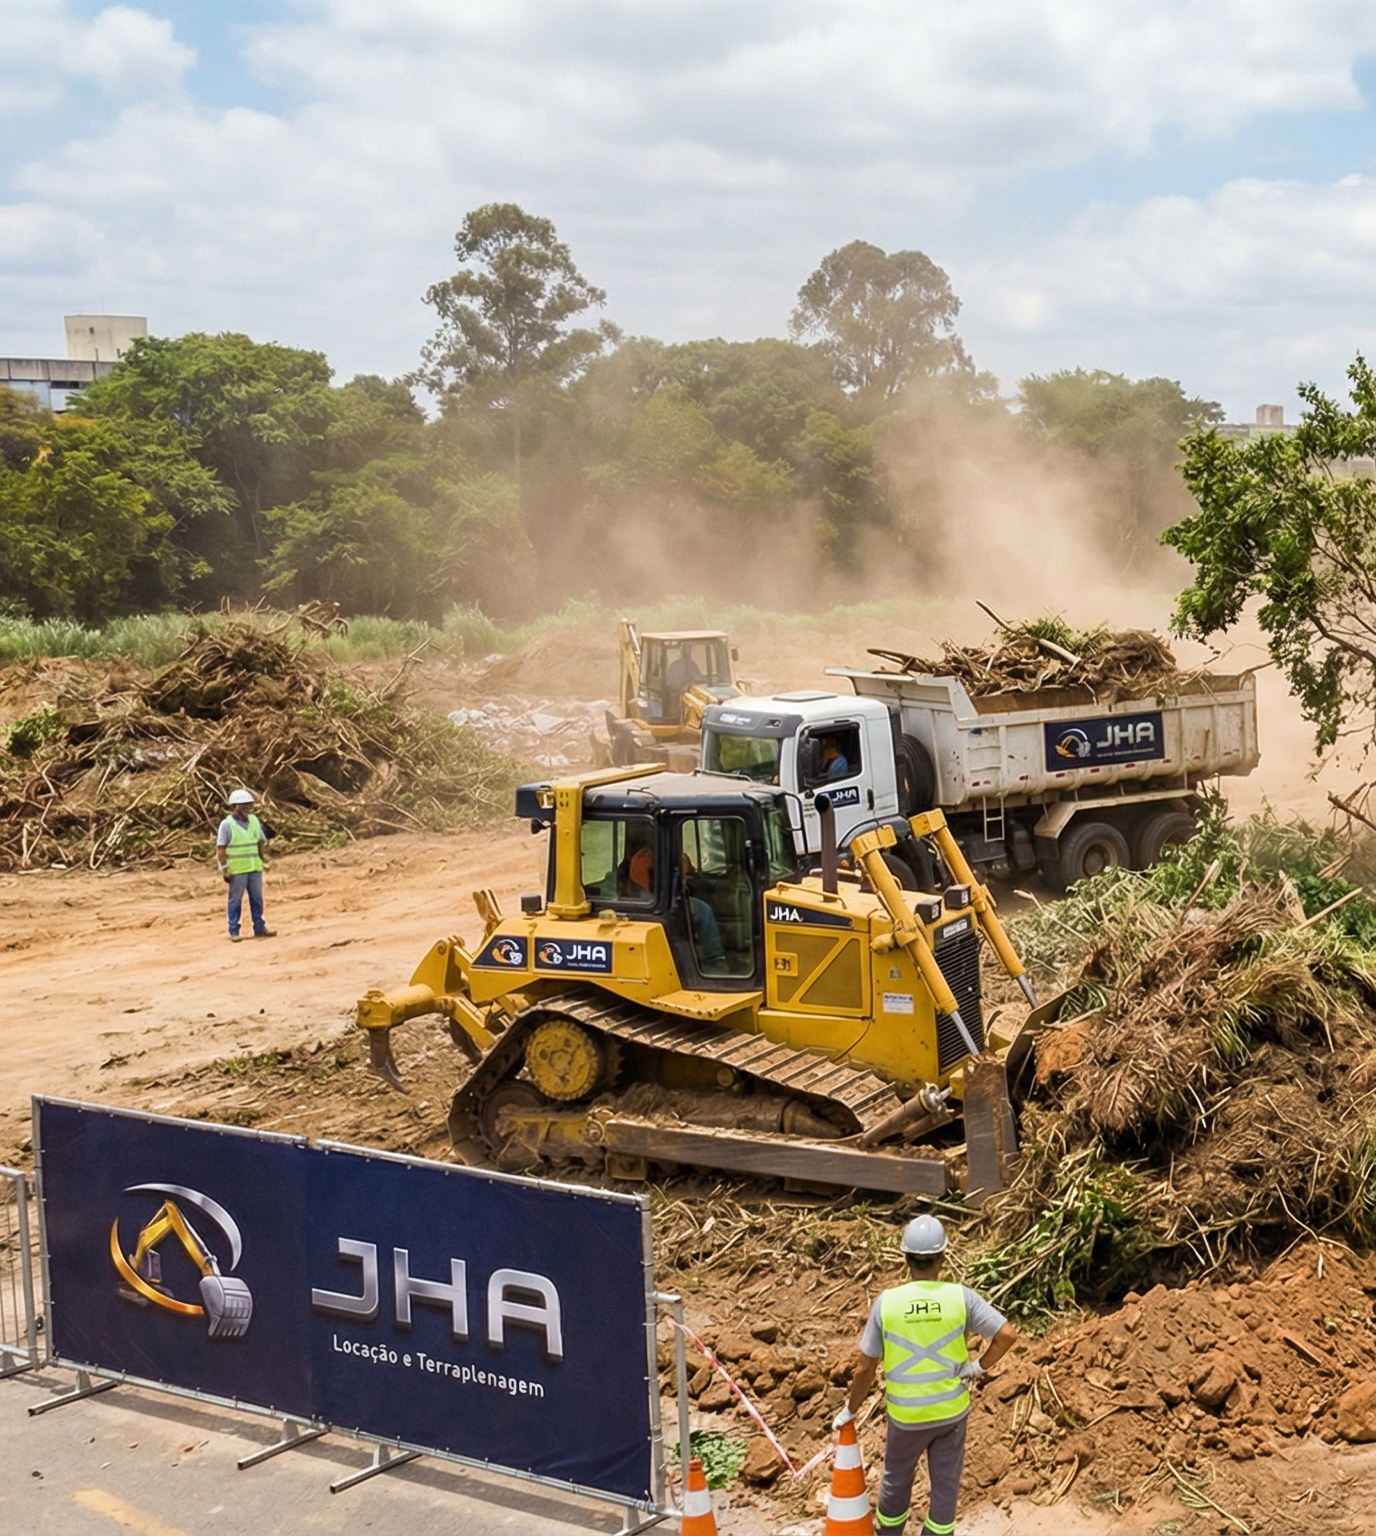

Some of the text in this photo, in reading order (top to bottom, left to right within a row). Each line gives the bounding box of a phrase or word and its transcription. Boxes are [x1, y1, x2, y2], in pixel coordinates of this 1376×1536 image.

[1096, 721, 1155, 748] JHA
[769, 906, 801, 922] JHA
[566, 944, 607, 962] JHA
[311, 1236, 564, 1359] JHA
[333, 1333, 545, 1398] Locação e Terraplenagem
